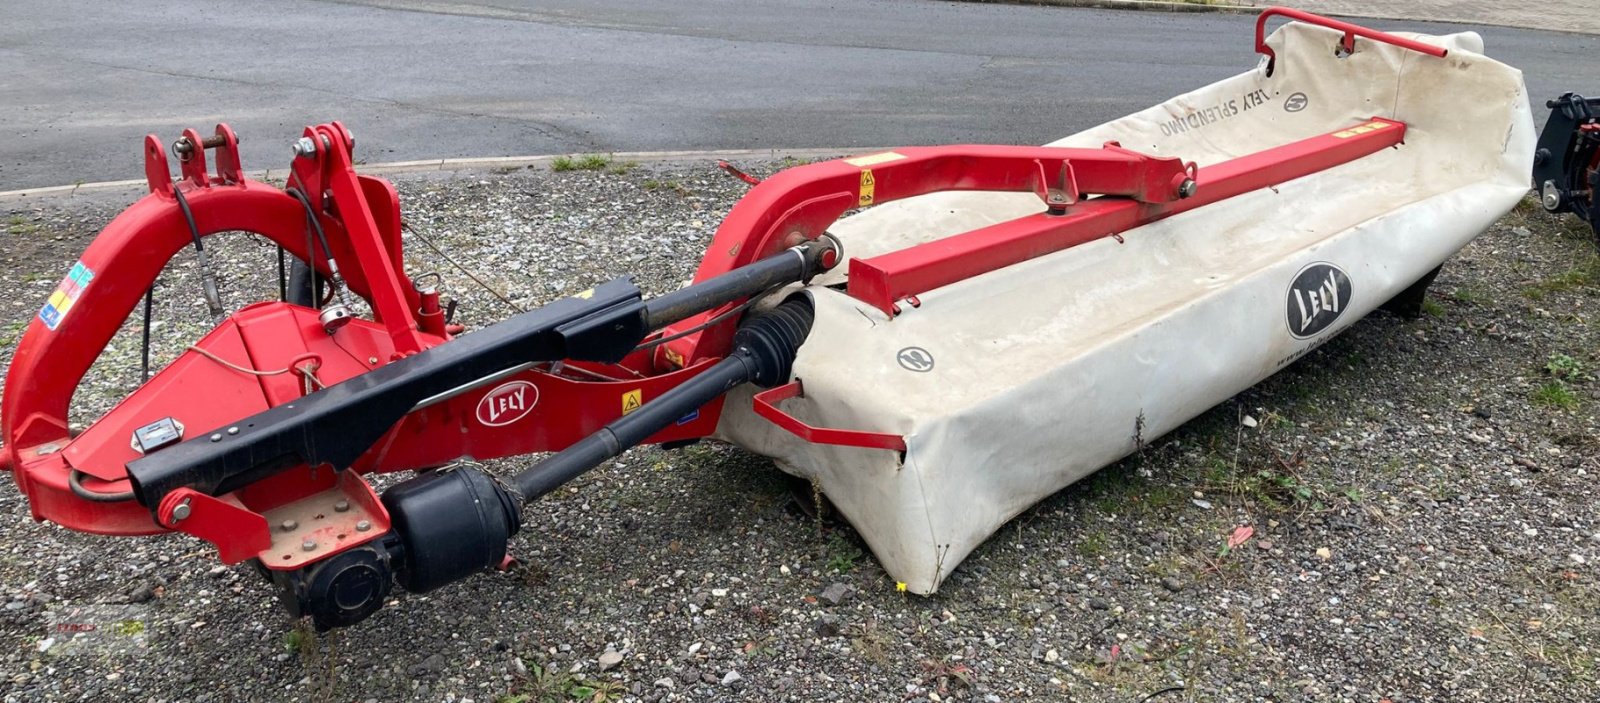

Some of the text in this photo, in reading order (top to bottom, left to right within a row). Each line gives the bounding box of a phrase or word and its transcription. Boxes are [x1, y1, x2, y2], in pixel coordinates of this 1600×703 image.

[1160, 88, 1270, 137] LELY SPLENDIMO
[1293, 268, 1339, 333] LELY
[488, 385, 525, 422] LELY
